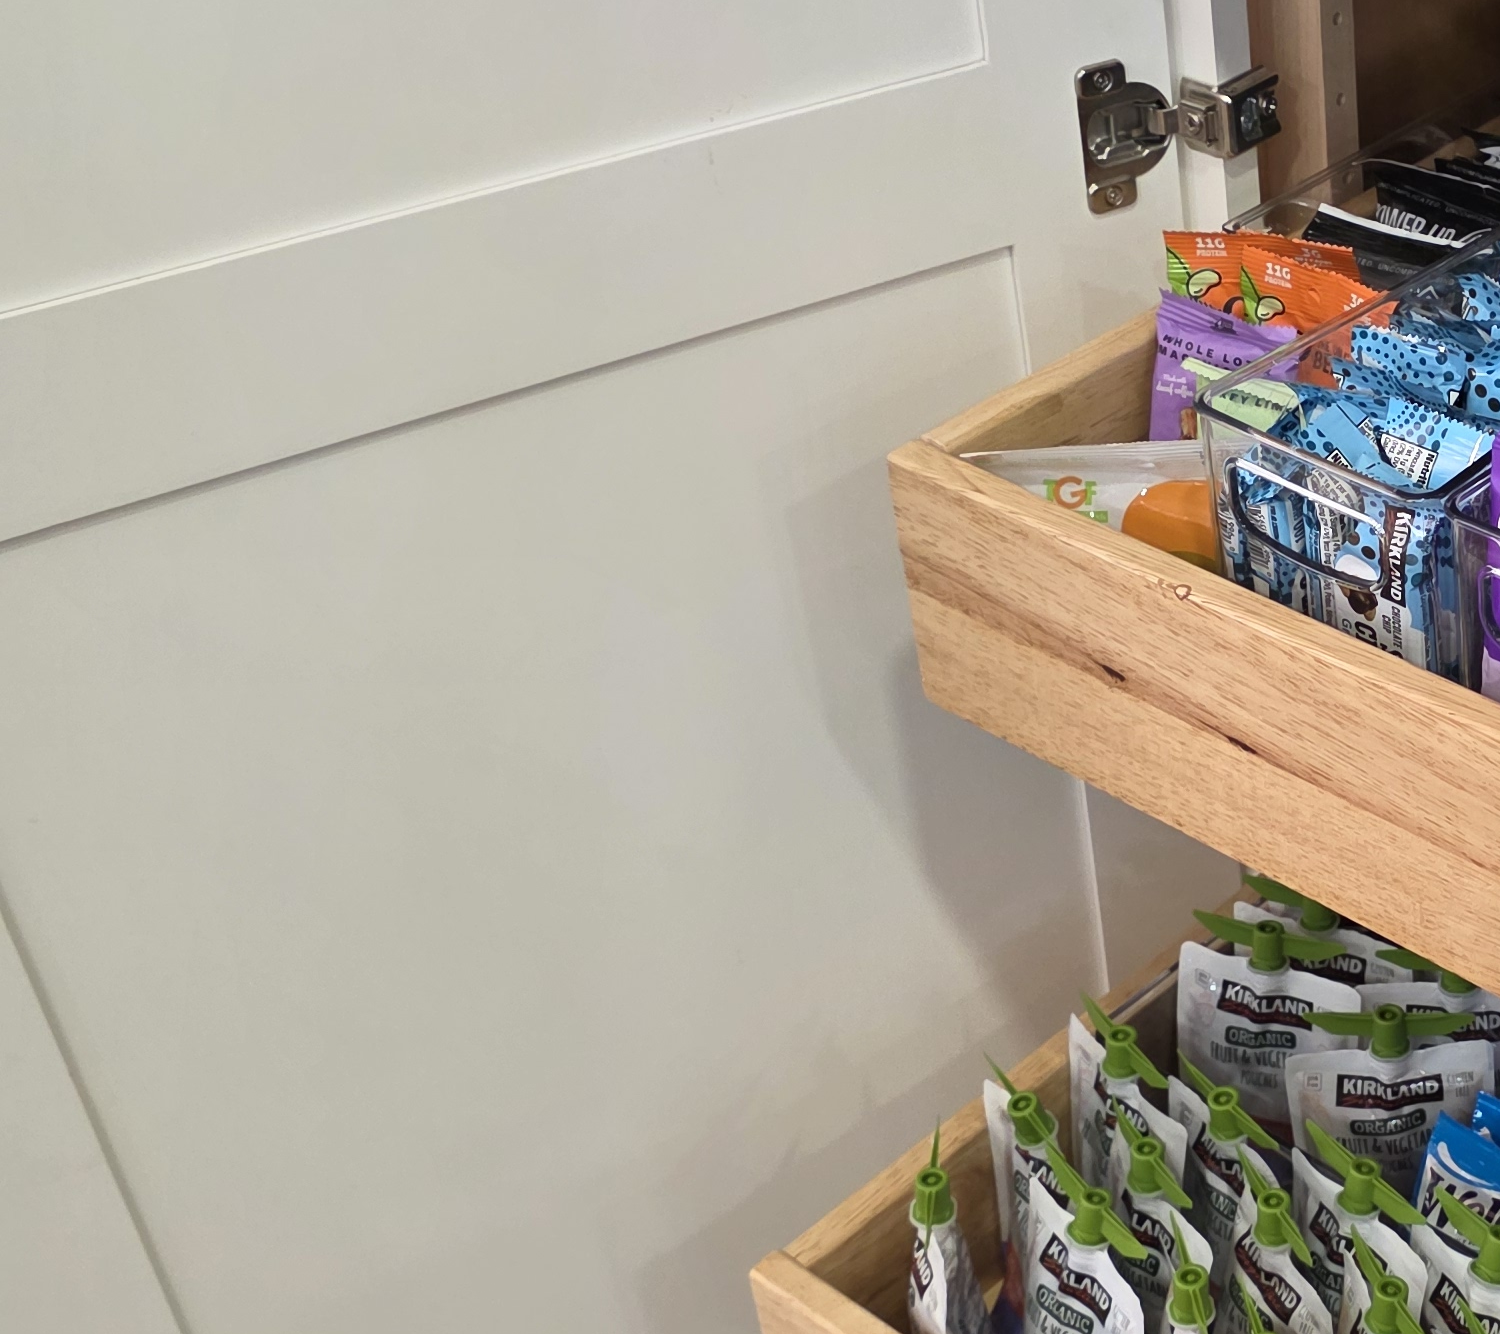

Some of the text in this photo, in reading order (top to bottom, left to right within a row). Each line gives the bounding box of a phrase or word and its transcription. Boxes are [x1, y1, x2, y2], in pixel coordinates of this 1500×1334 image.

[1162, 334, 1215, 359] WHOLE
[1388, 511, 1412, 601] KIRKLAND
[1225, 983, 1311, 1015] KIRKLAND
[1228, 1029, 1293, 1047] ORGANIC
[1342, 1076, 1441, 1099] KIRKLAND
[1353, 1112, 1424, 1134] ORGANIC
